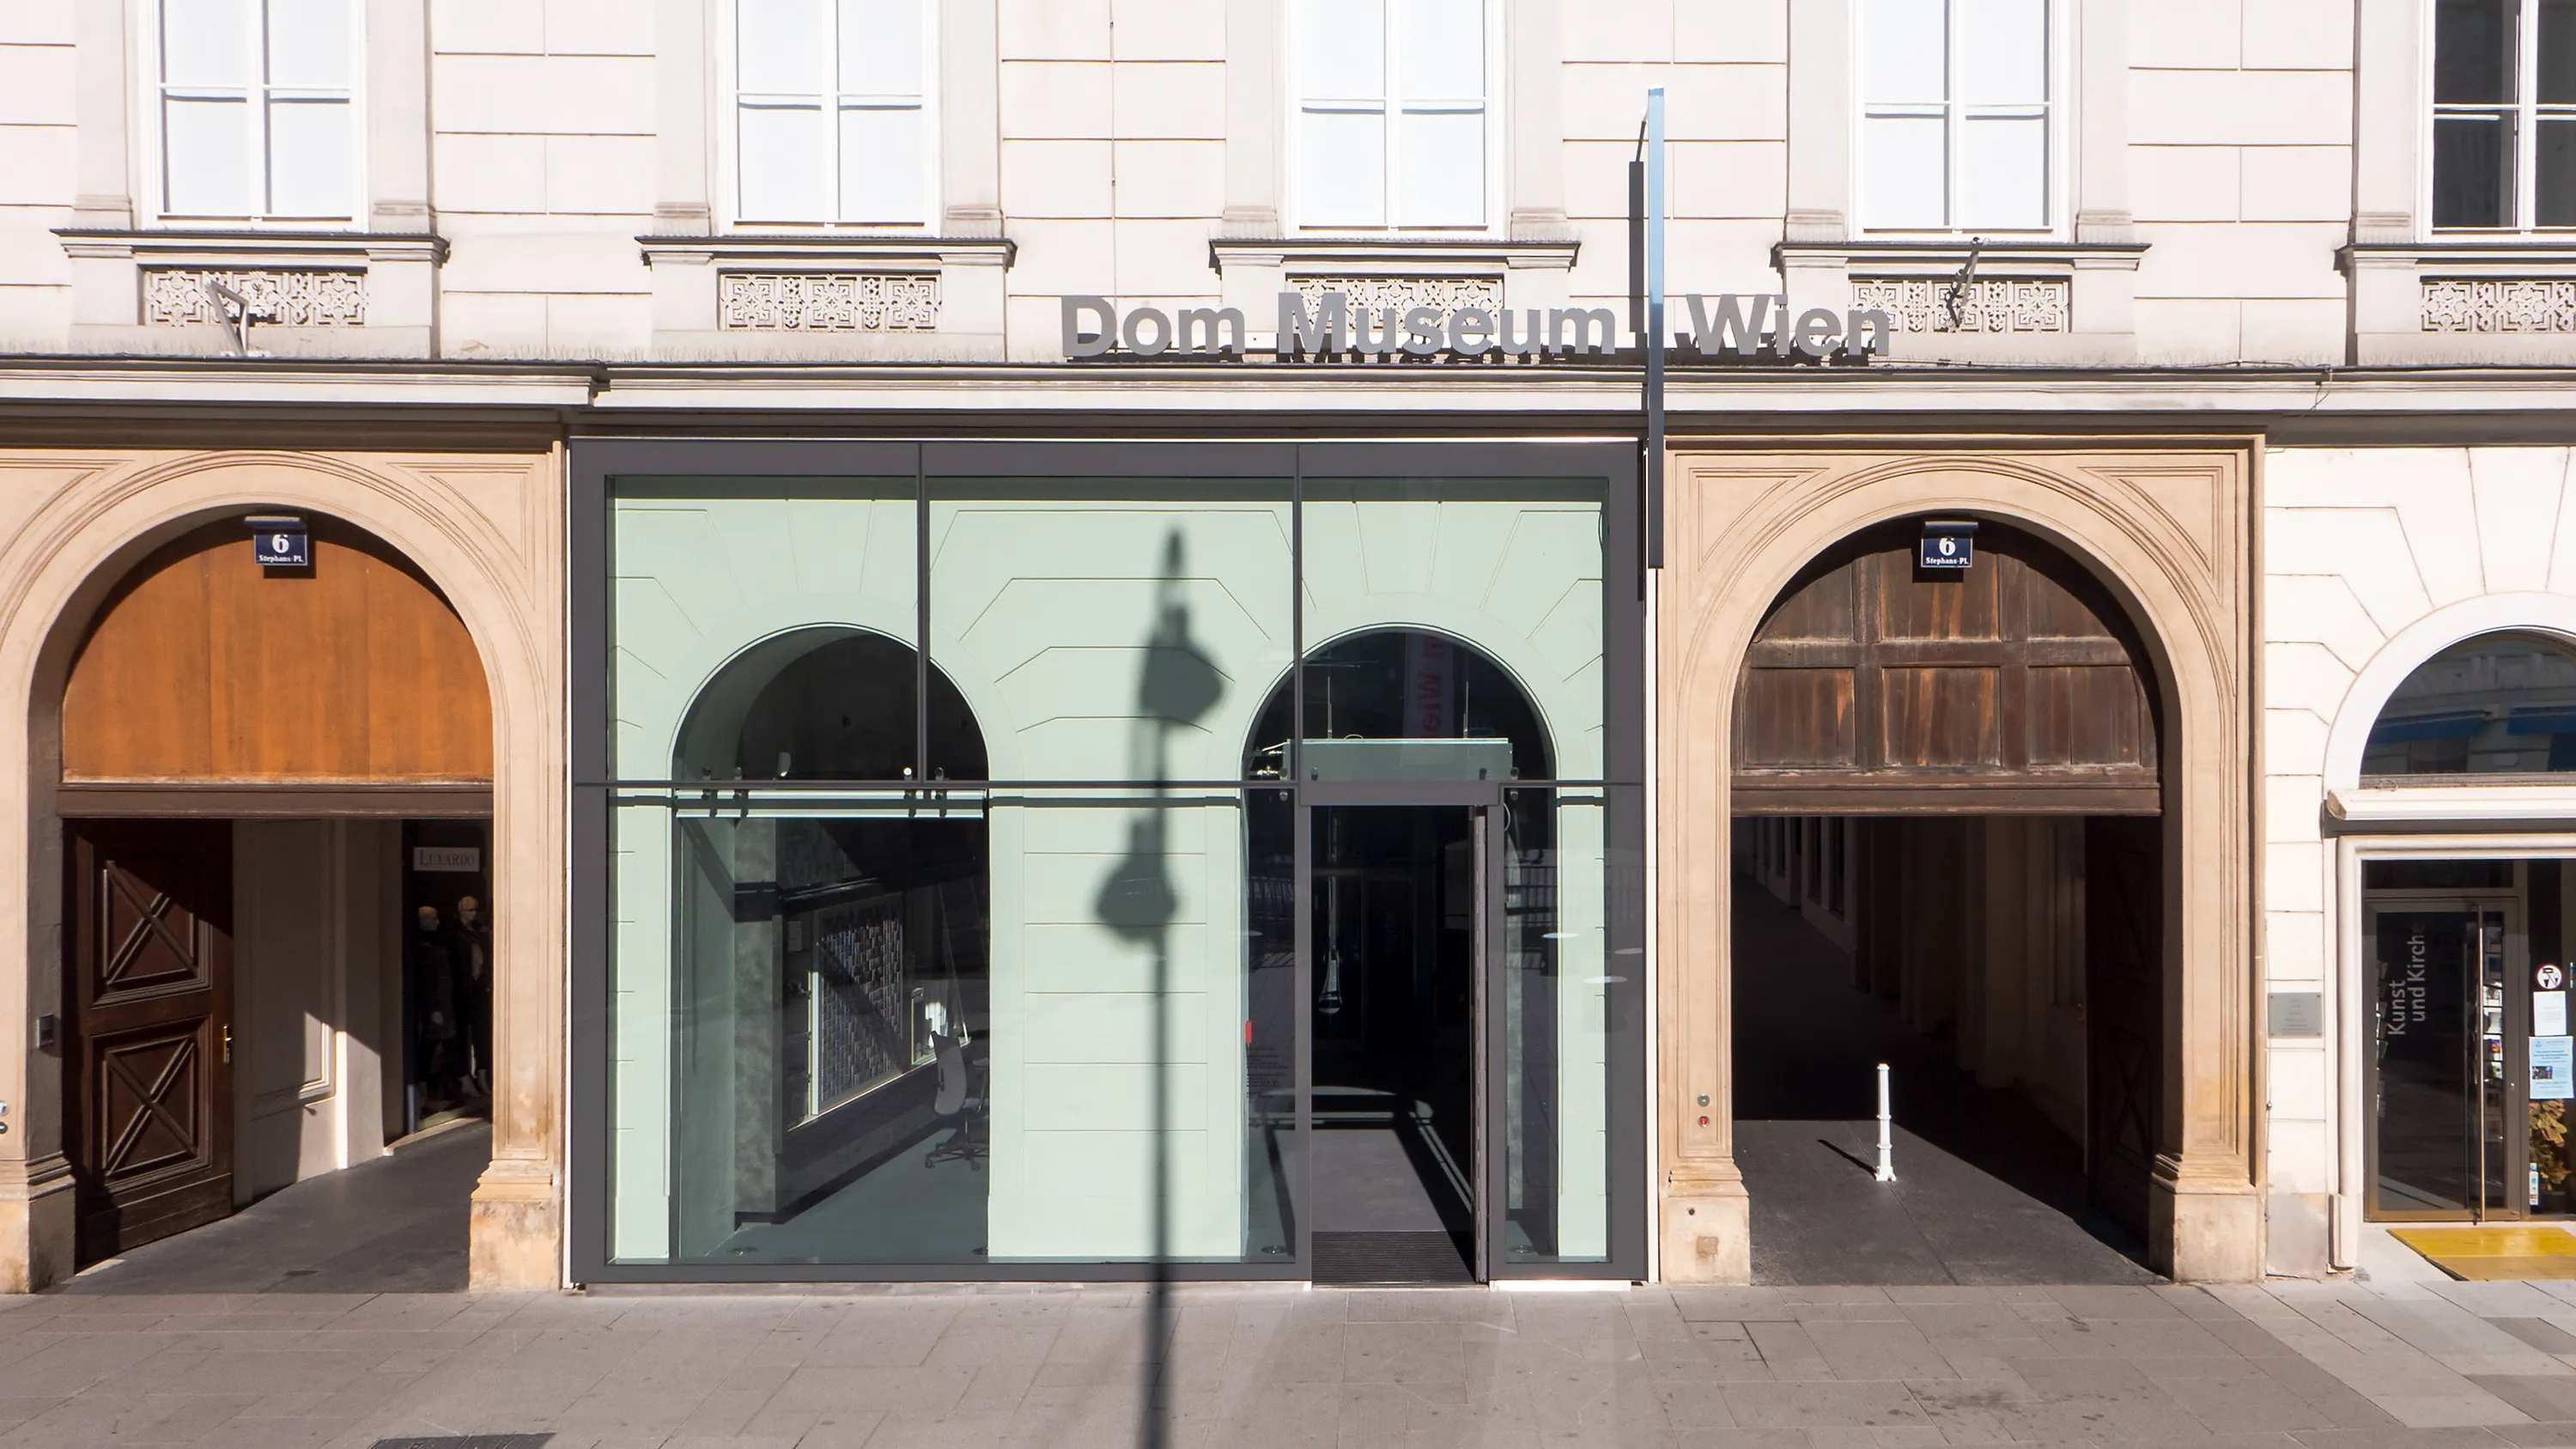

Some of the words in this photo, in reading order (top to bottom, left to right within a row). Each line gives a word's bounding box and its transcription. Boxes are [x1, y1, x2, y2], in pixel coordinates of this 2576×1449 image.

[1061, 295, 1245, 357] Dom
[1278, 292, 1615, 356] Museum
[1686, 294, 1890, 356] Wien
[272, 533, 290, 554] 6
[1939, 538, 1956, 557] 6
[2387, 979, 2406, 1035] Kunst
[2407, 987, 2426, 1022] und
